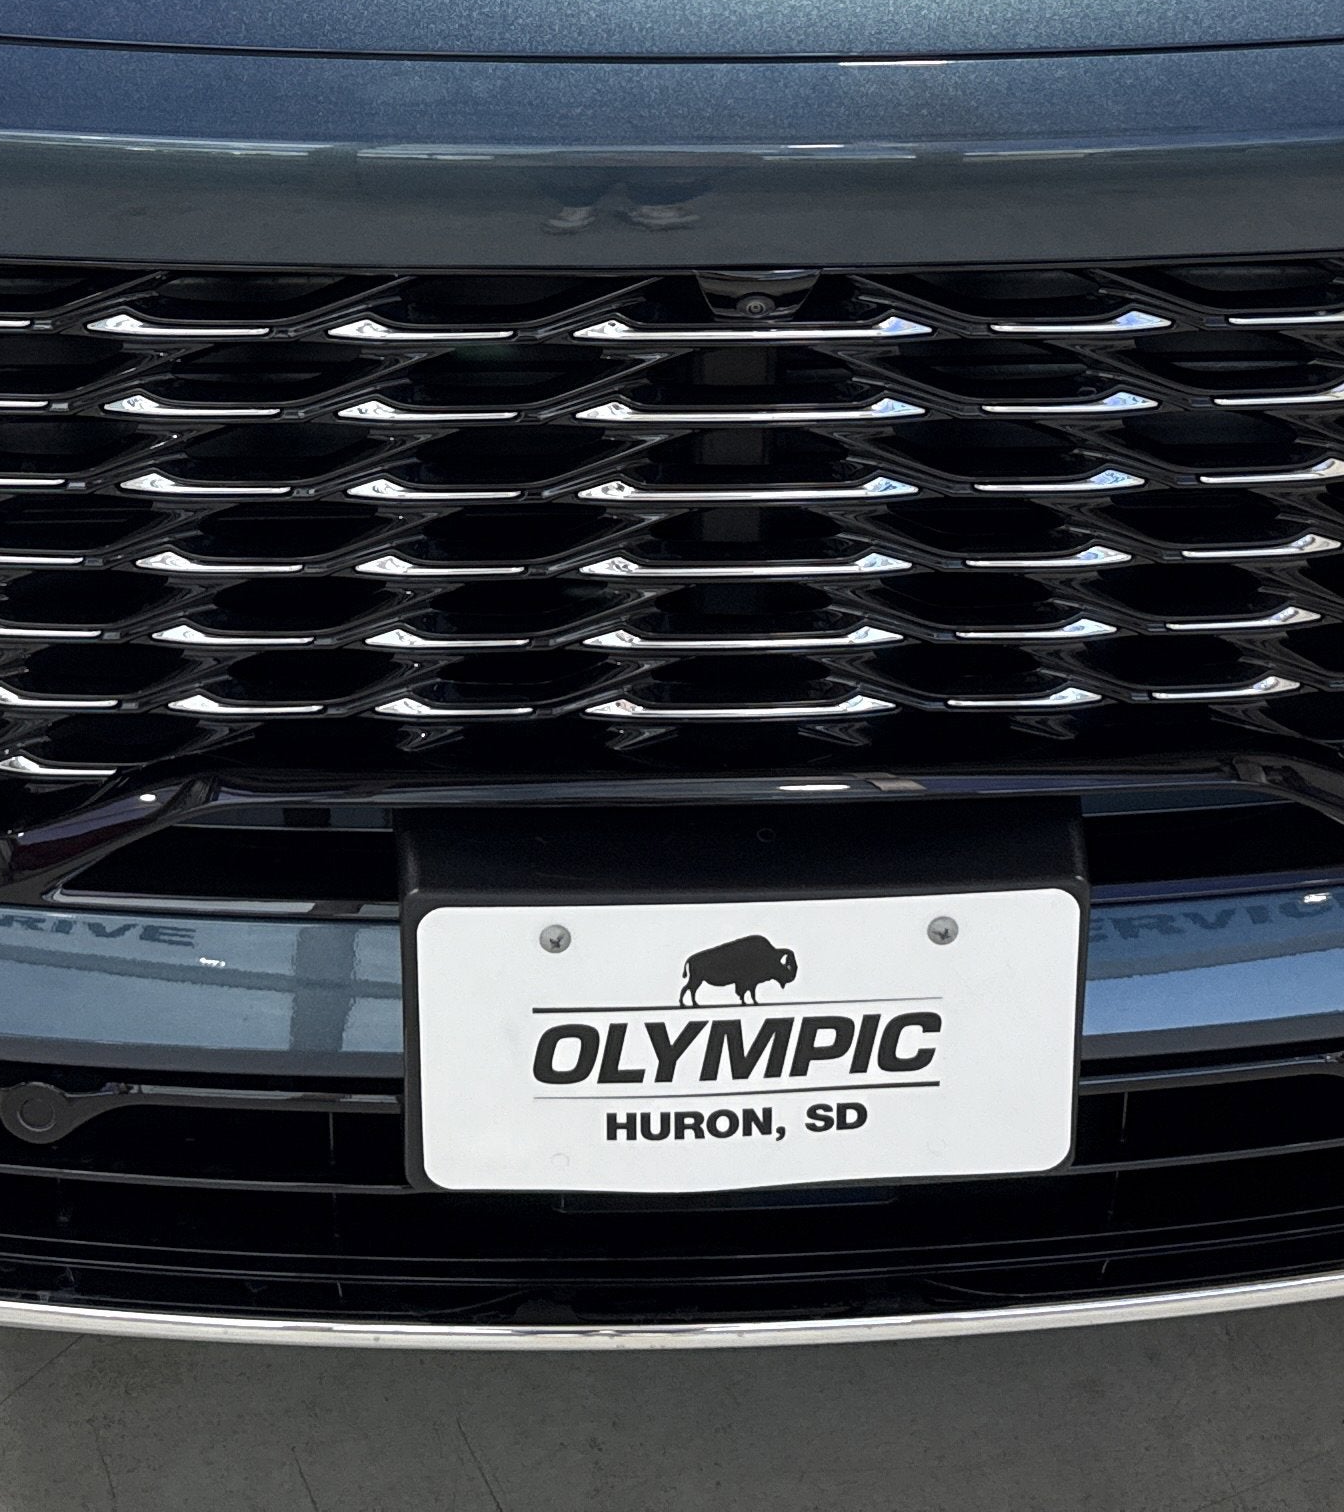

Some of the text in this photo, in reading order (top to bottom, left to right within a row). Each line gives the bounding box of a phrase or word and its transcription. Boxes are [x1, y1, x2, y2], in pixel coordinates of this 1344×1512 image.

[532, 1011, 943, 1085] OLYMPIC
[606, 1101, 869, 1143] HURON, SD
